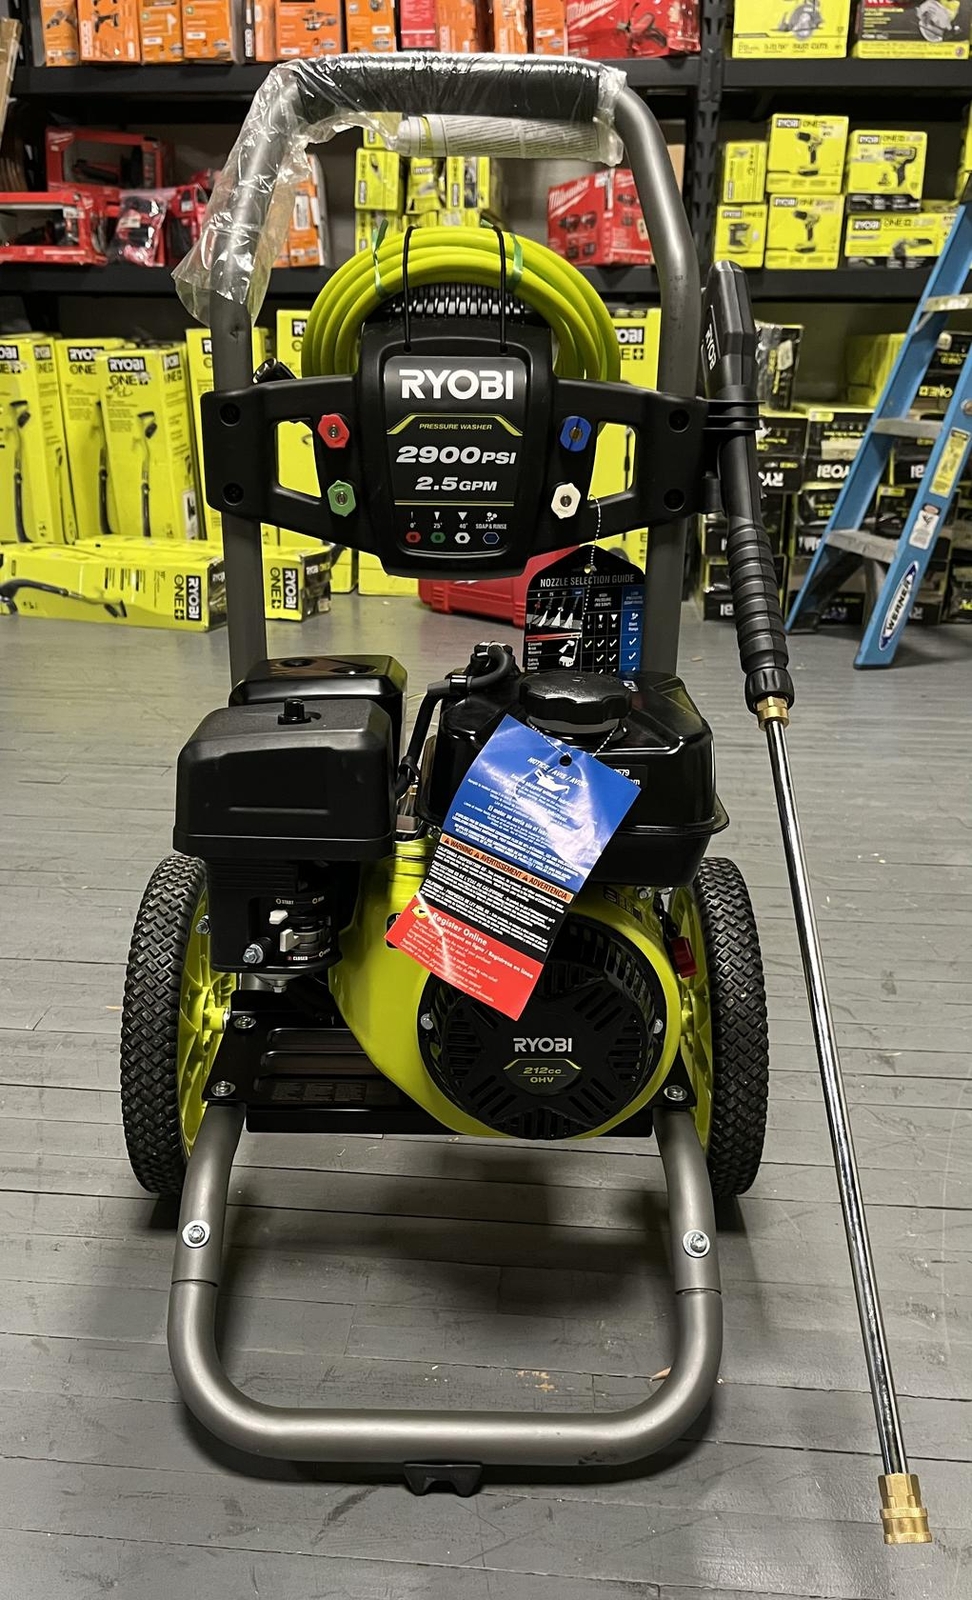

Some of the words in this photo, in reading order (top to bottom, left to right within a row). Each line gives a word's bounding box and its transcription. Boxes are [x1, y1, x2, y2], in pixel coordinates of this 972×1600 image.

[616, 329, 643, 343] OBI
[69, 348, 96, 361] RYO
[108, 358, 145, 371] RYOBI
[399, 369, 514, 400] RYOBI
[285, 570, 297, 609] RYOBI
[540, 577, 568, 588] NOZZLE
[570, 575, 610, 586] SELECTION
[611, 574, 635, 584] GUIDE
[188, 577, 200, 619] RYOBI
[886, 580, 912, 631] WERNER
[527, 756, 549, 771] NOTICE
[551, 767, 567, 779] AVIS
[449, 839, 474, 855] WARNING
[479, 852, 522, 879] AVERTISSEMENT
[528, 875, 568, 900] ADVERTENCIA
[430, 911, 463, 934] Register
[462, 927, 488, 946] Online
[513, 1037, 572, 1053] RYOBI
[523, 1066, 562, 1075] 212cc
[530, 1076, 554, 1084] OHV
